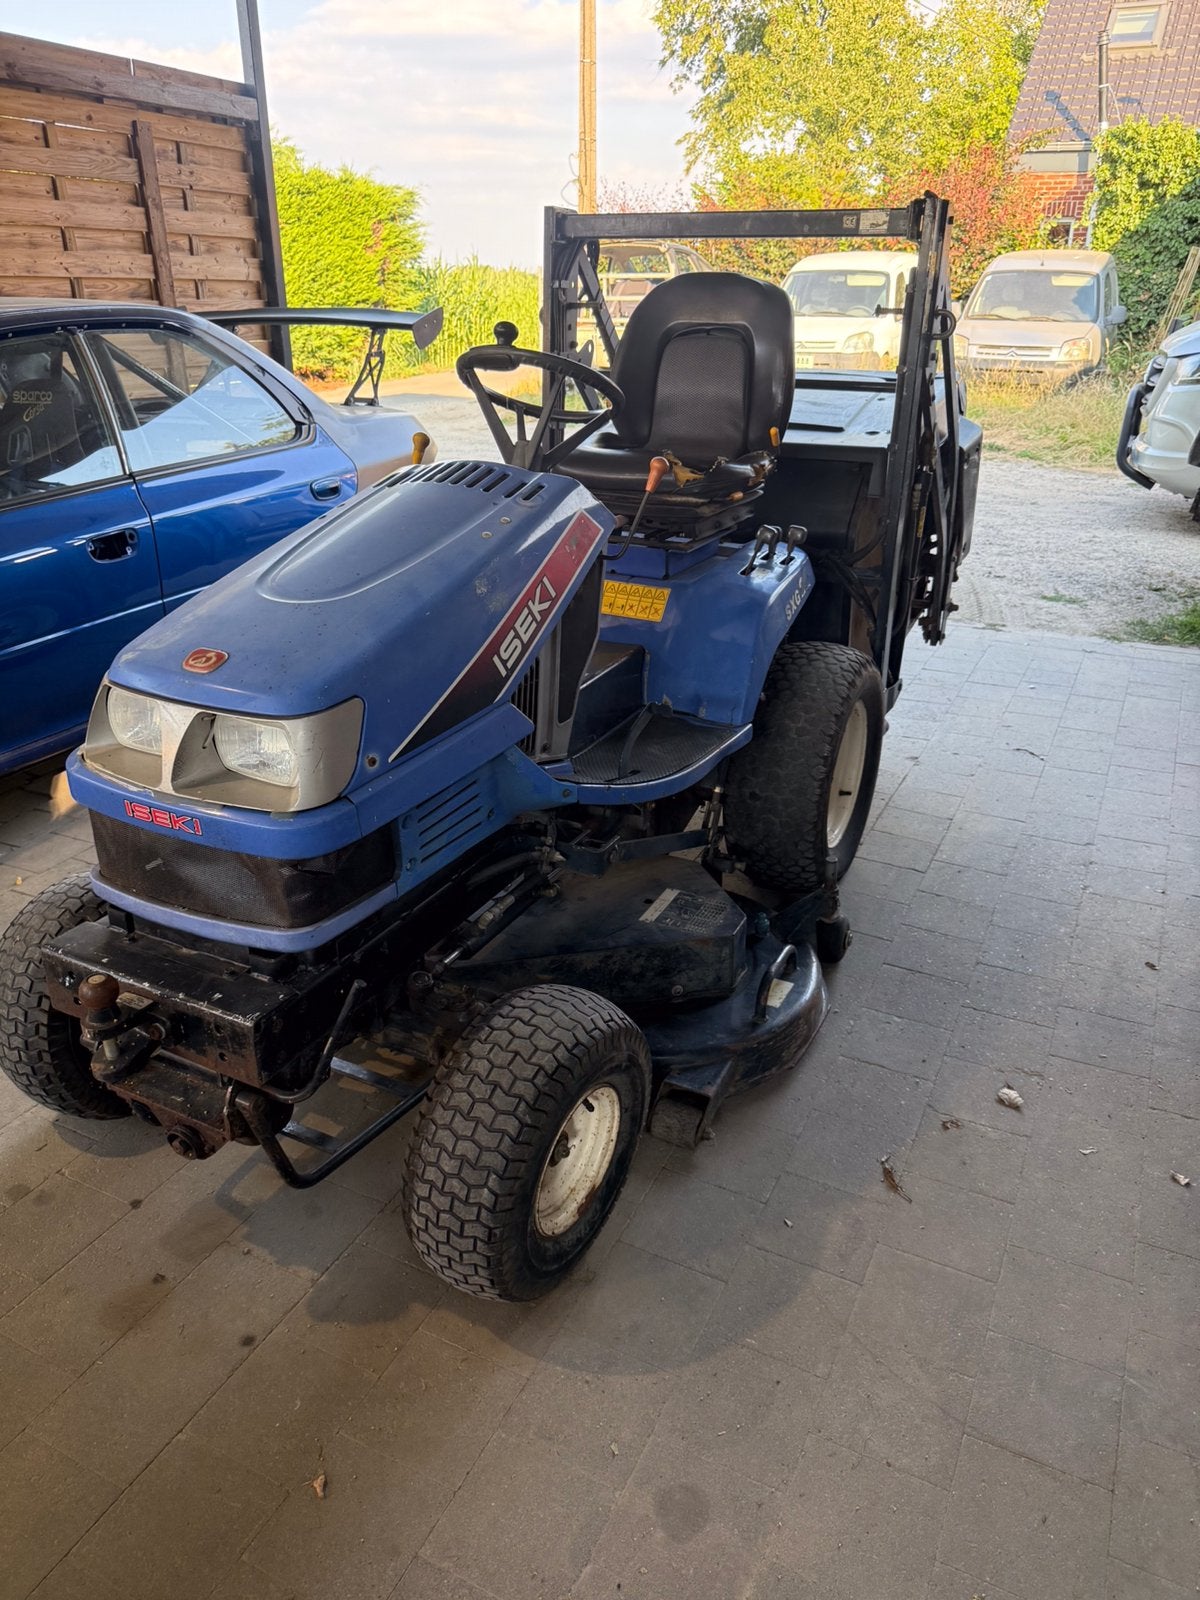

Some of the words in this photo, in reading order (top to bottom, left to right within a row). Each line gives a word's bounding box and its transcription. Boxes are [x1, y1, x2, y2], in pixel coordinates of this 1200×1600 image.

[12, 390, 53, 404] sparco
[492, 575, 557, 678] ISEKI
[123, 799, 203, 836] ISEKI
